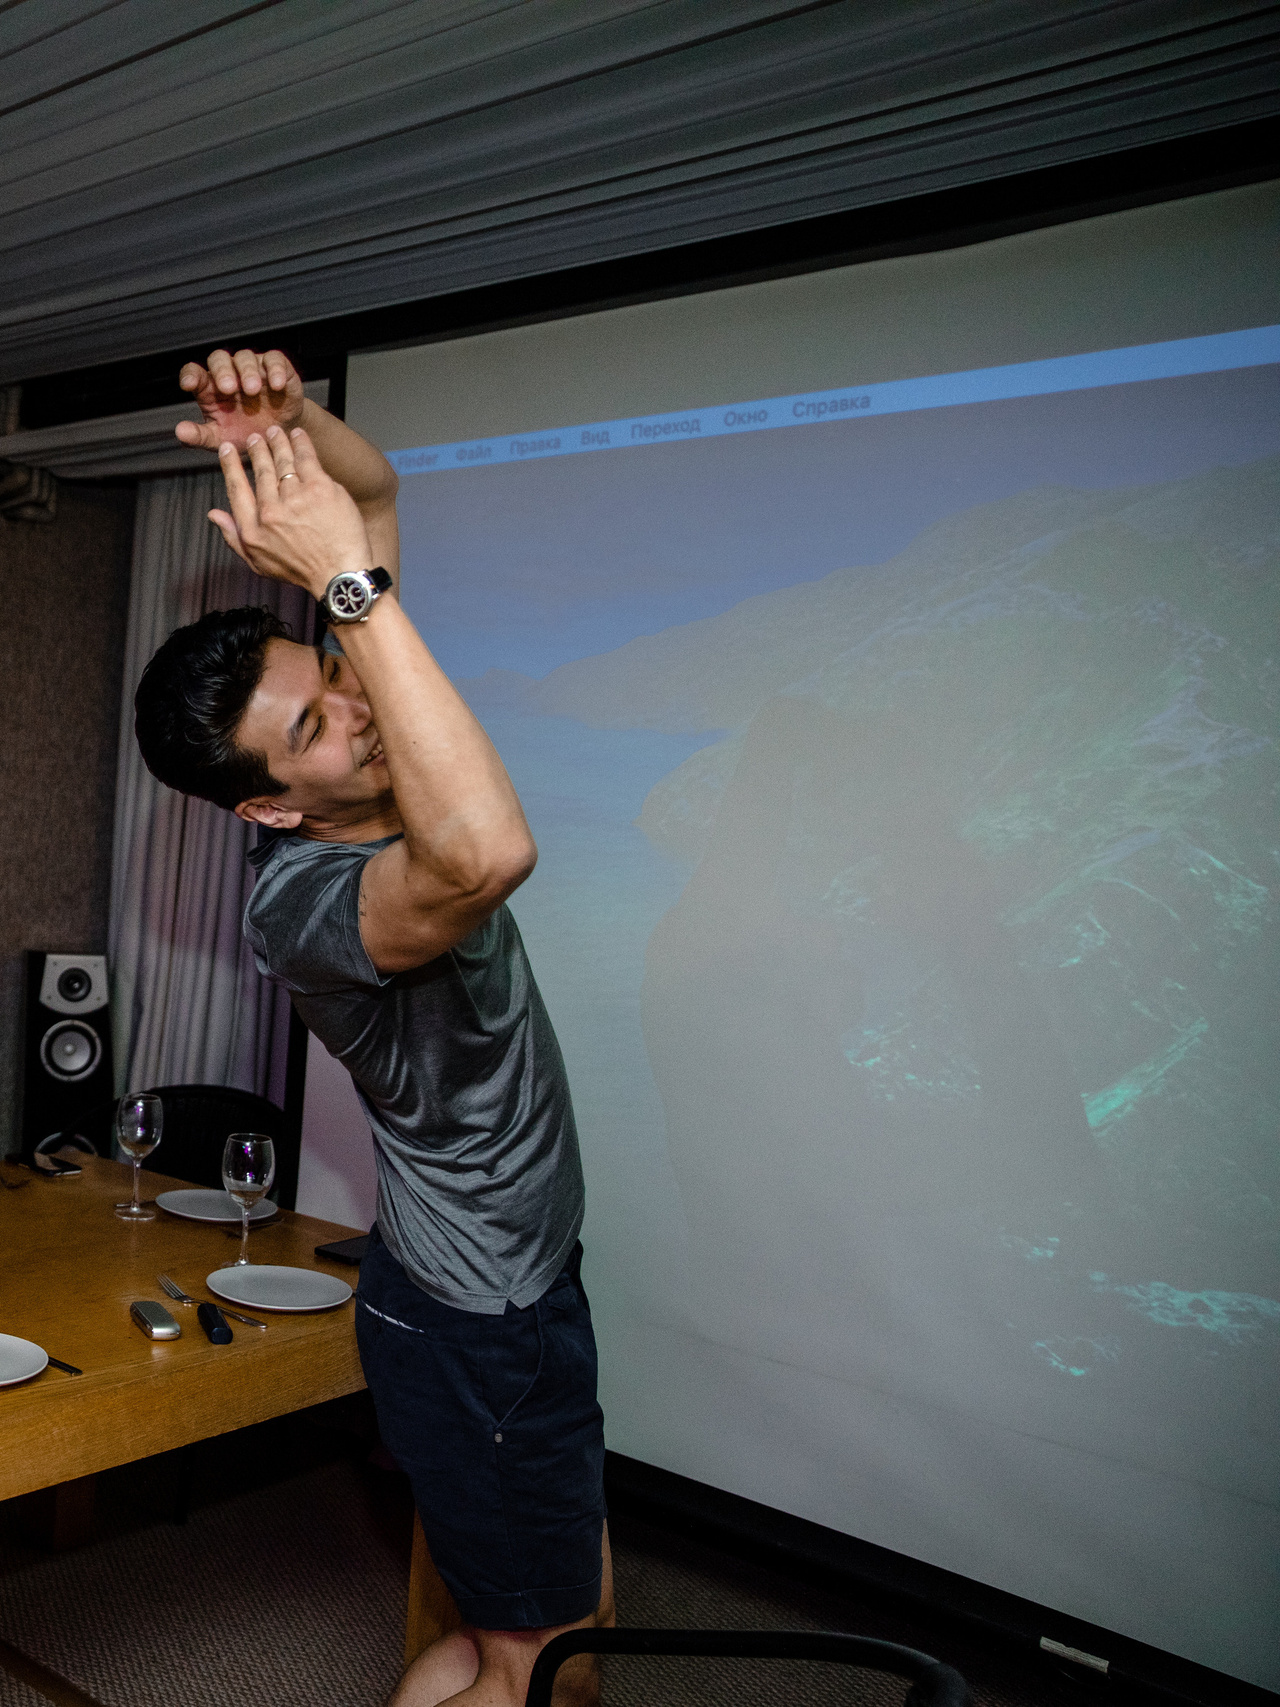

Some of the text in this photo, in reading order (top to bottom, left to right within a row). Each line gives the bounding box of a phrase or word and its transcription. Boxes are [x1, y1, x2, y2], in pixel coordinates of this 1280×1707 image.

[455, 444, 492, 462] Файл
[509, 436, 561, 456] Правка
[580, 429, 610, 447] Вид
[630, 418, 701, 440] Переход
[723, 409, 768, 427] Окно
[792, 395, 871, 420] Справка
